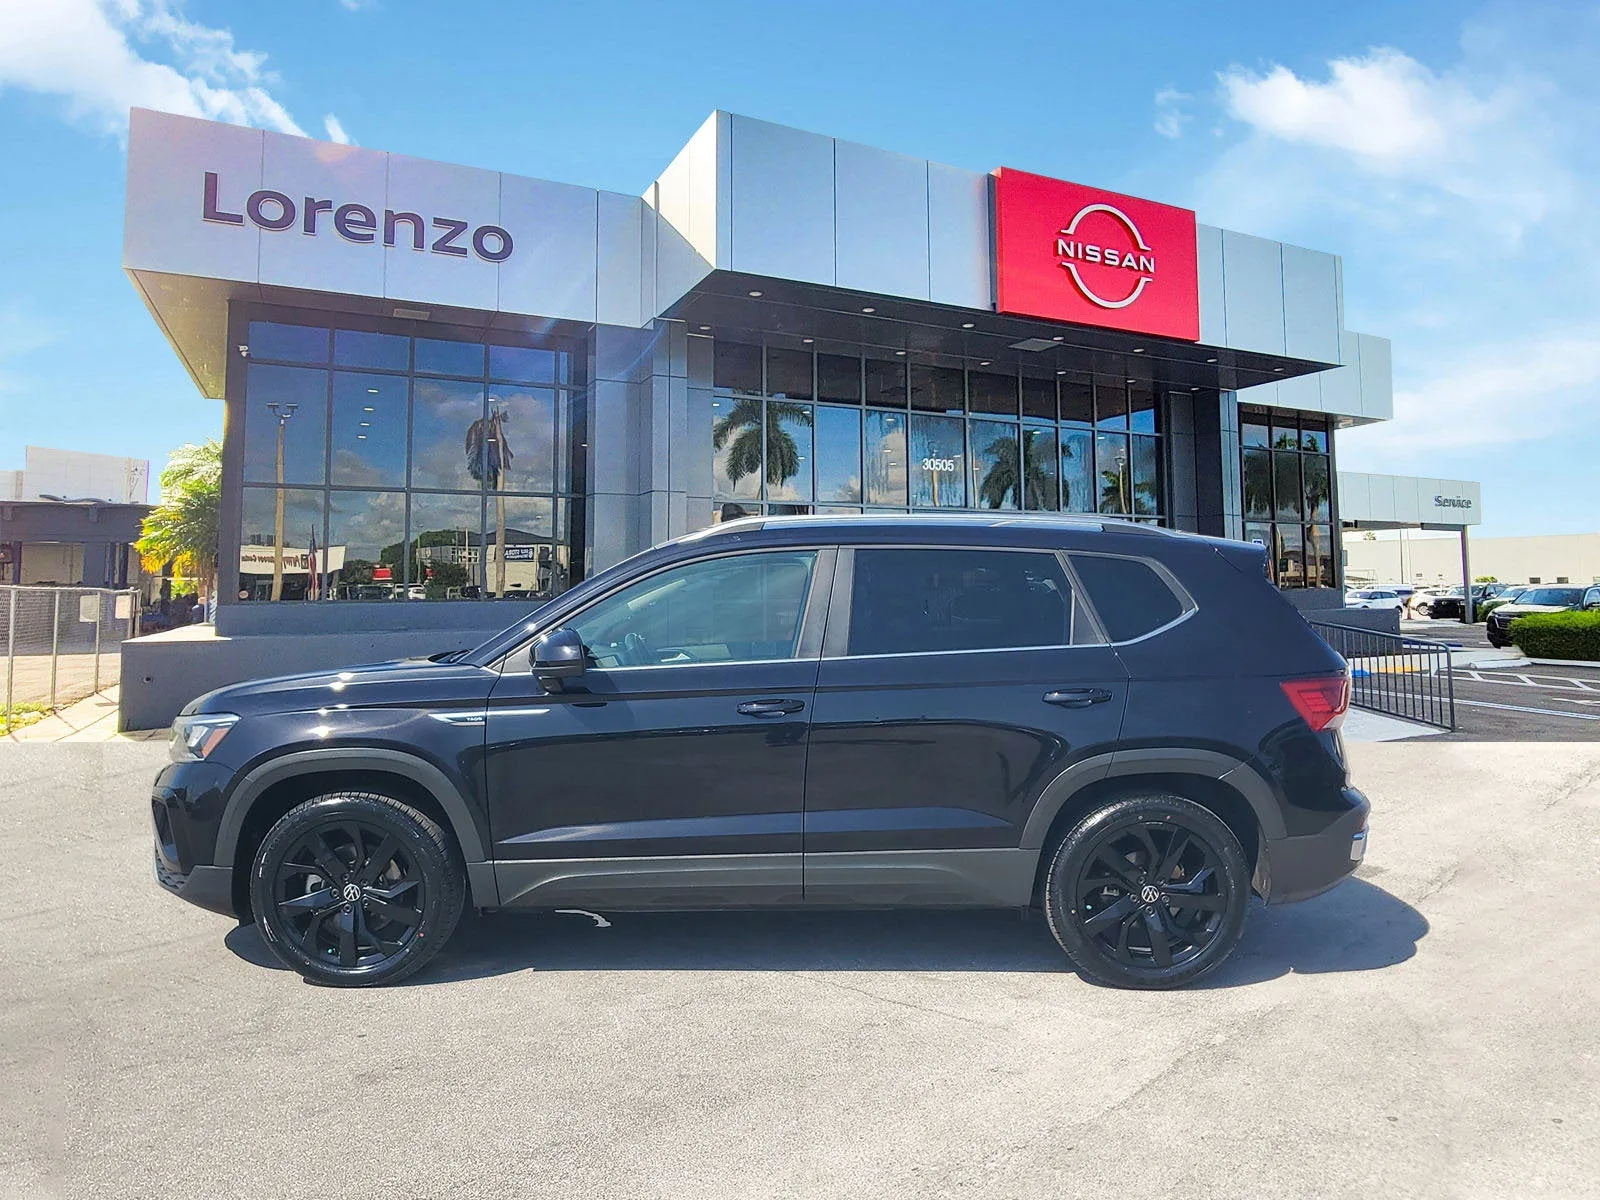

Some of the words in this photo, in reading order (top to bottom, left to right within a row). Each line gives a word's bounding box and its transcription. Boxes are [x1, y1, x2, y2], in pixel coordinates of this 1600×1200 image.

[202, 171, 514, 262] Lorenzo
[1057, 238, 1155, 273] NISSAN
[922, 458, 954, 471] 30505
[1434, 495, 1472, 508] Service
